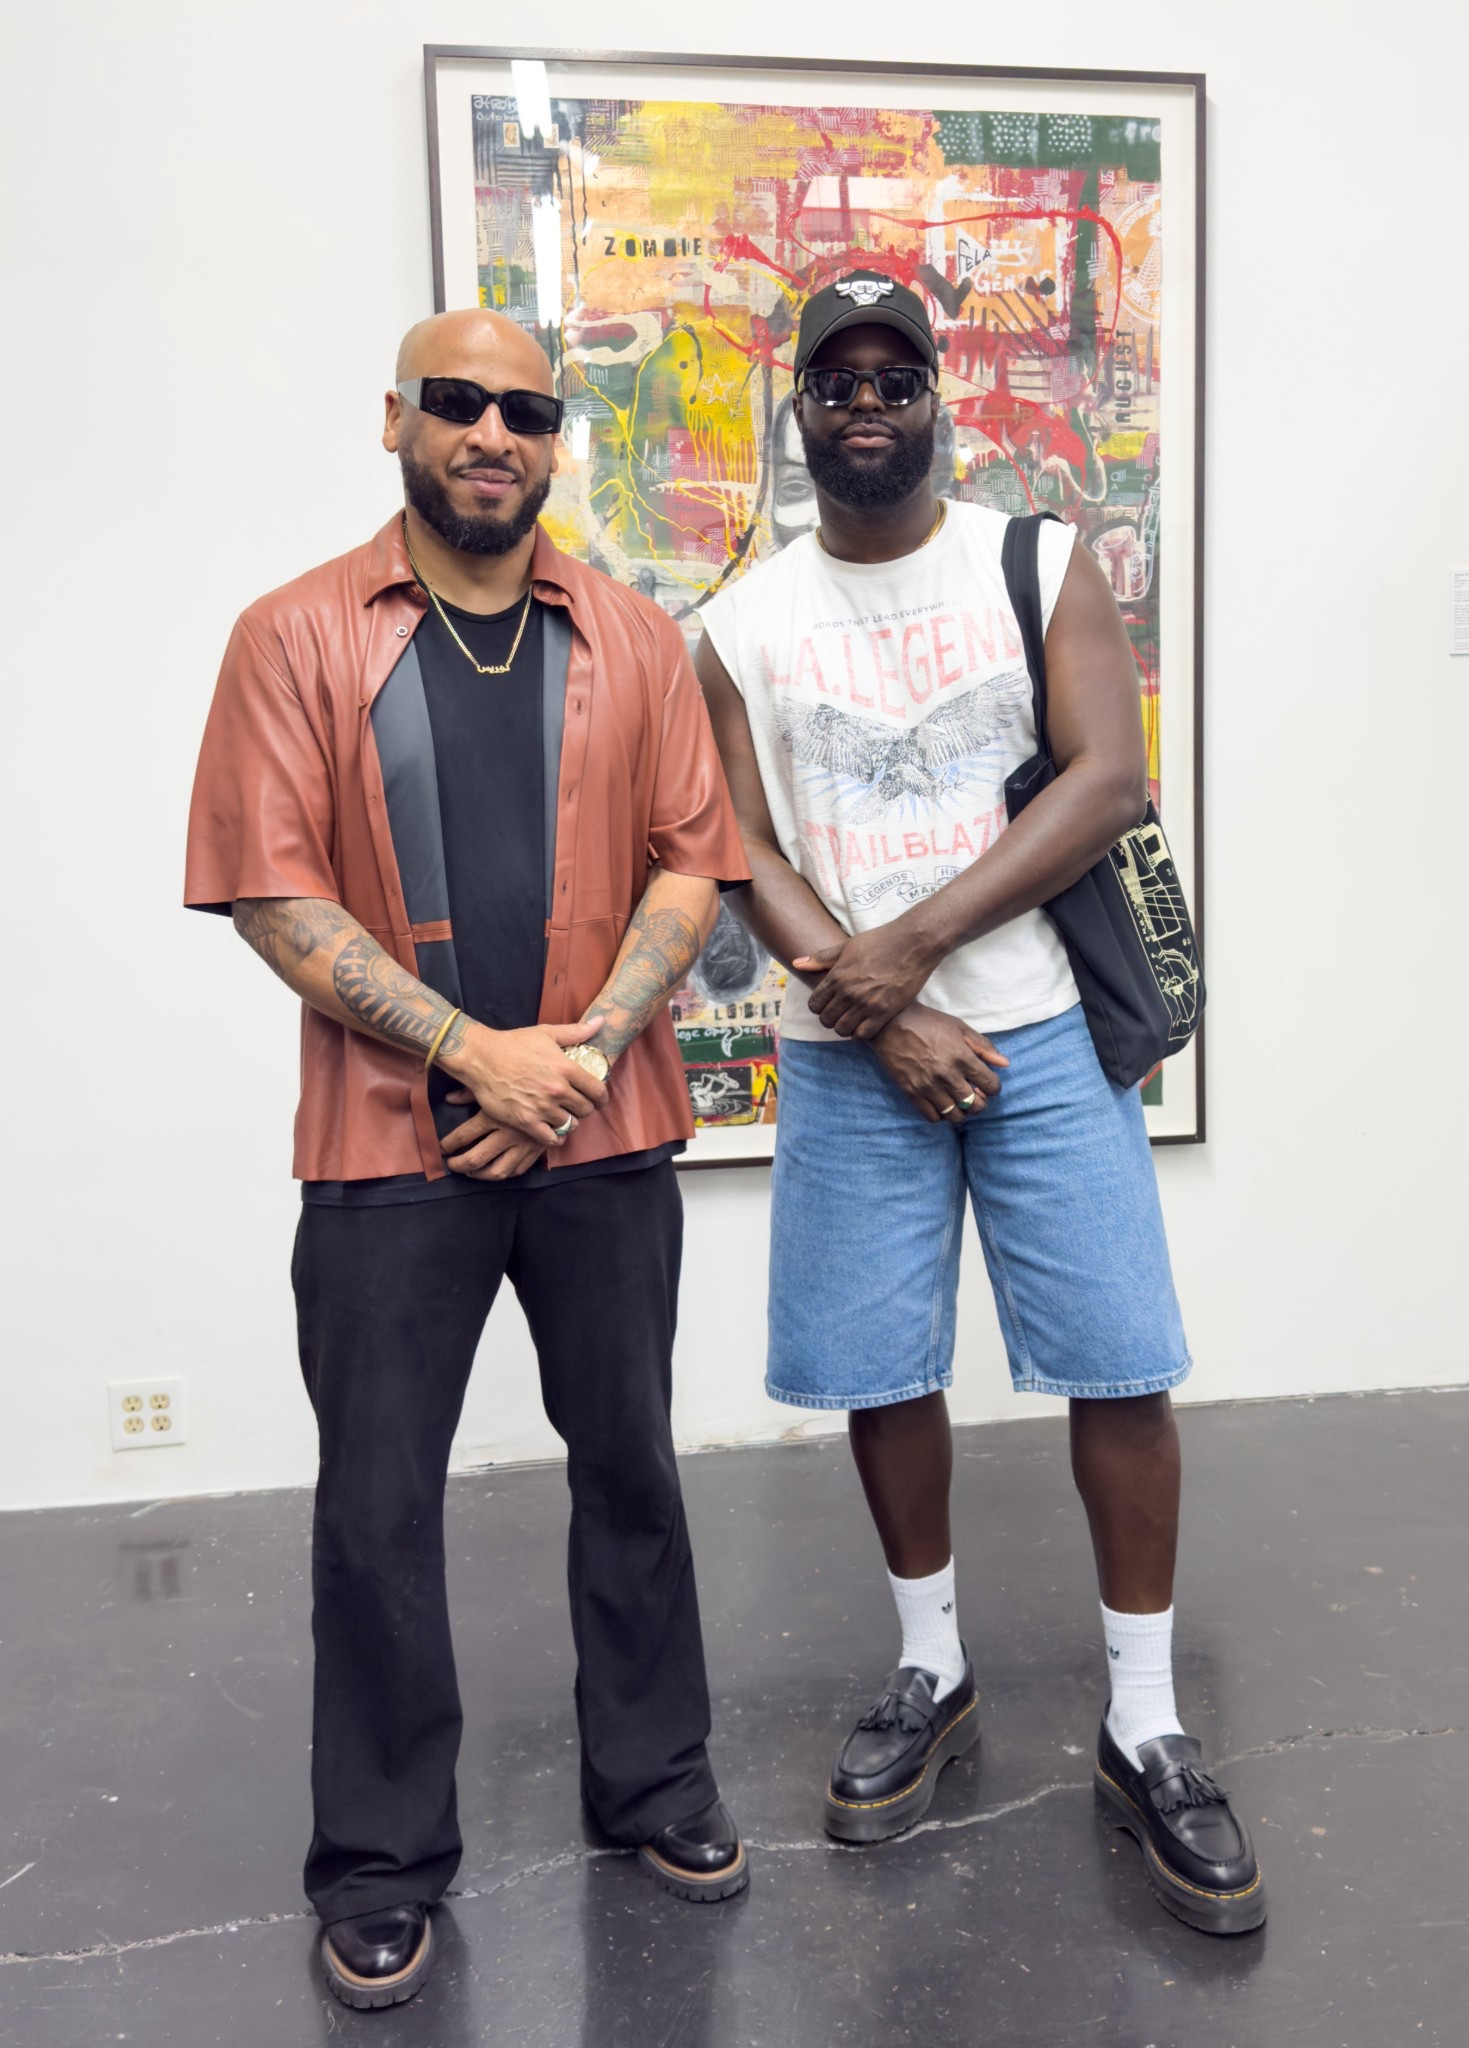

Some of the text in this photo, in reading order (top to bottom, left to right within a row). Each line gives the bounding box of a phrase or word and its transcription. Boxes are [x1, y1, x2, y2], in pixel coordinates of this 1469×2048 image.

[847, 615, 870, 627] THAT
[872, 612, 898, 623] LEAD
[863, 873, 908, 902] LEGENDS
